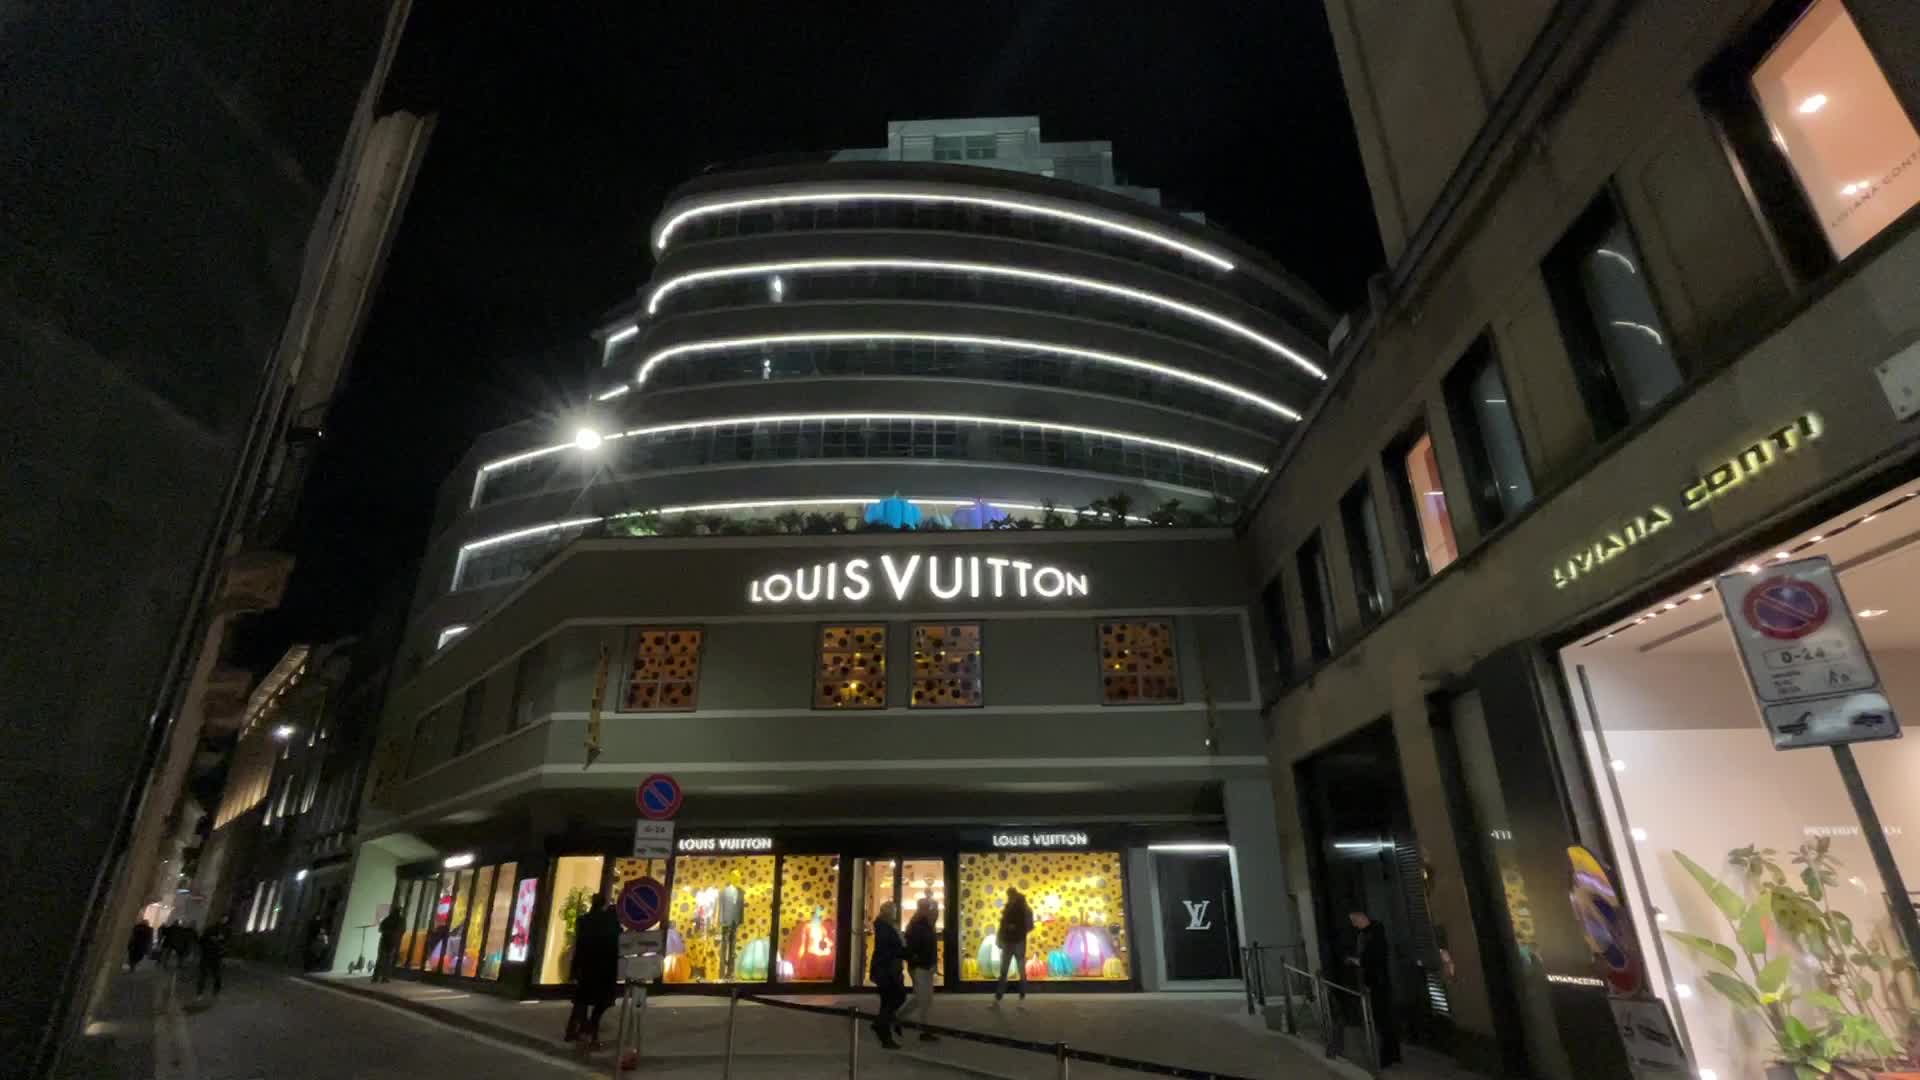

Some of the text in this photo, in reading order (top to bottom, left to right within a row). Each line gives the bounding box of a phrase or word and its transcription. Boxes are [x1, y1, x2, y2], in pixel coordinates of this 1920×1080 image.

[1681, 411, 1823, 511] CONTI
[751, 554, 1088, 602] LOUIS VUITTON
[678, 838, 772, 850] LOUIS VUITTON
[992, 833, 1087, 847] LOUIS VUITTON
